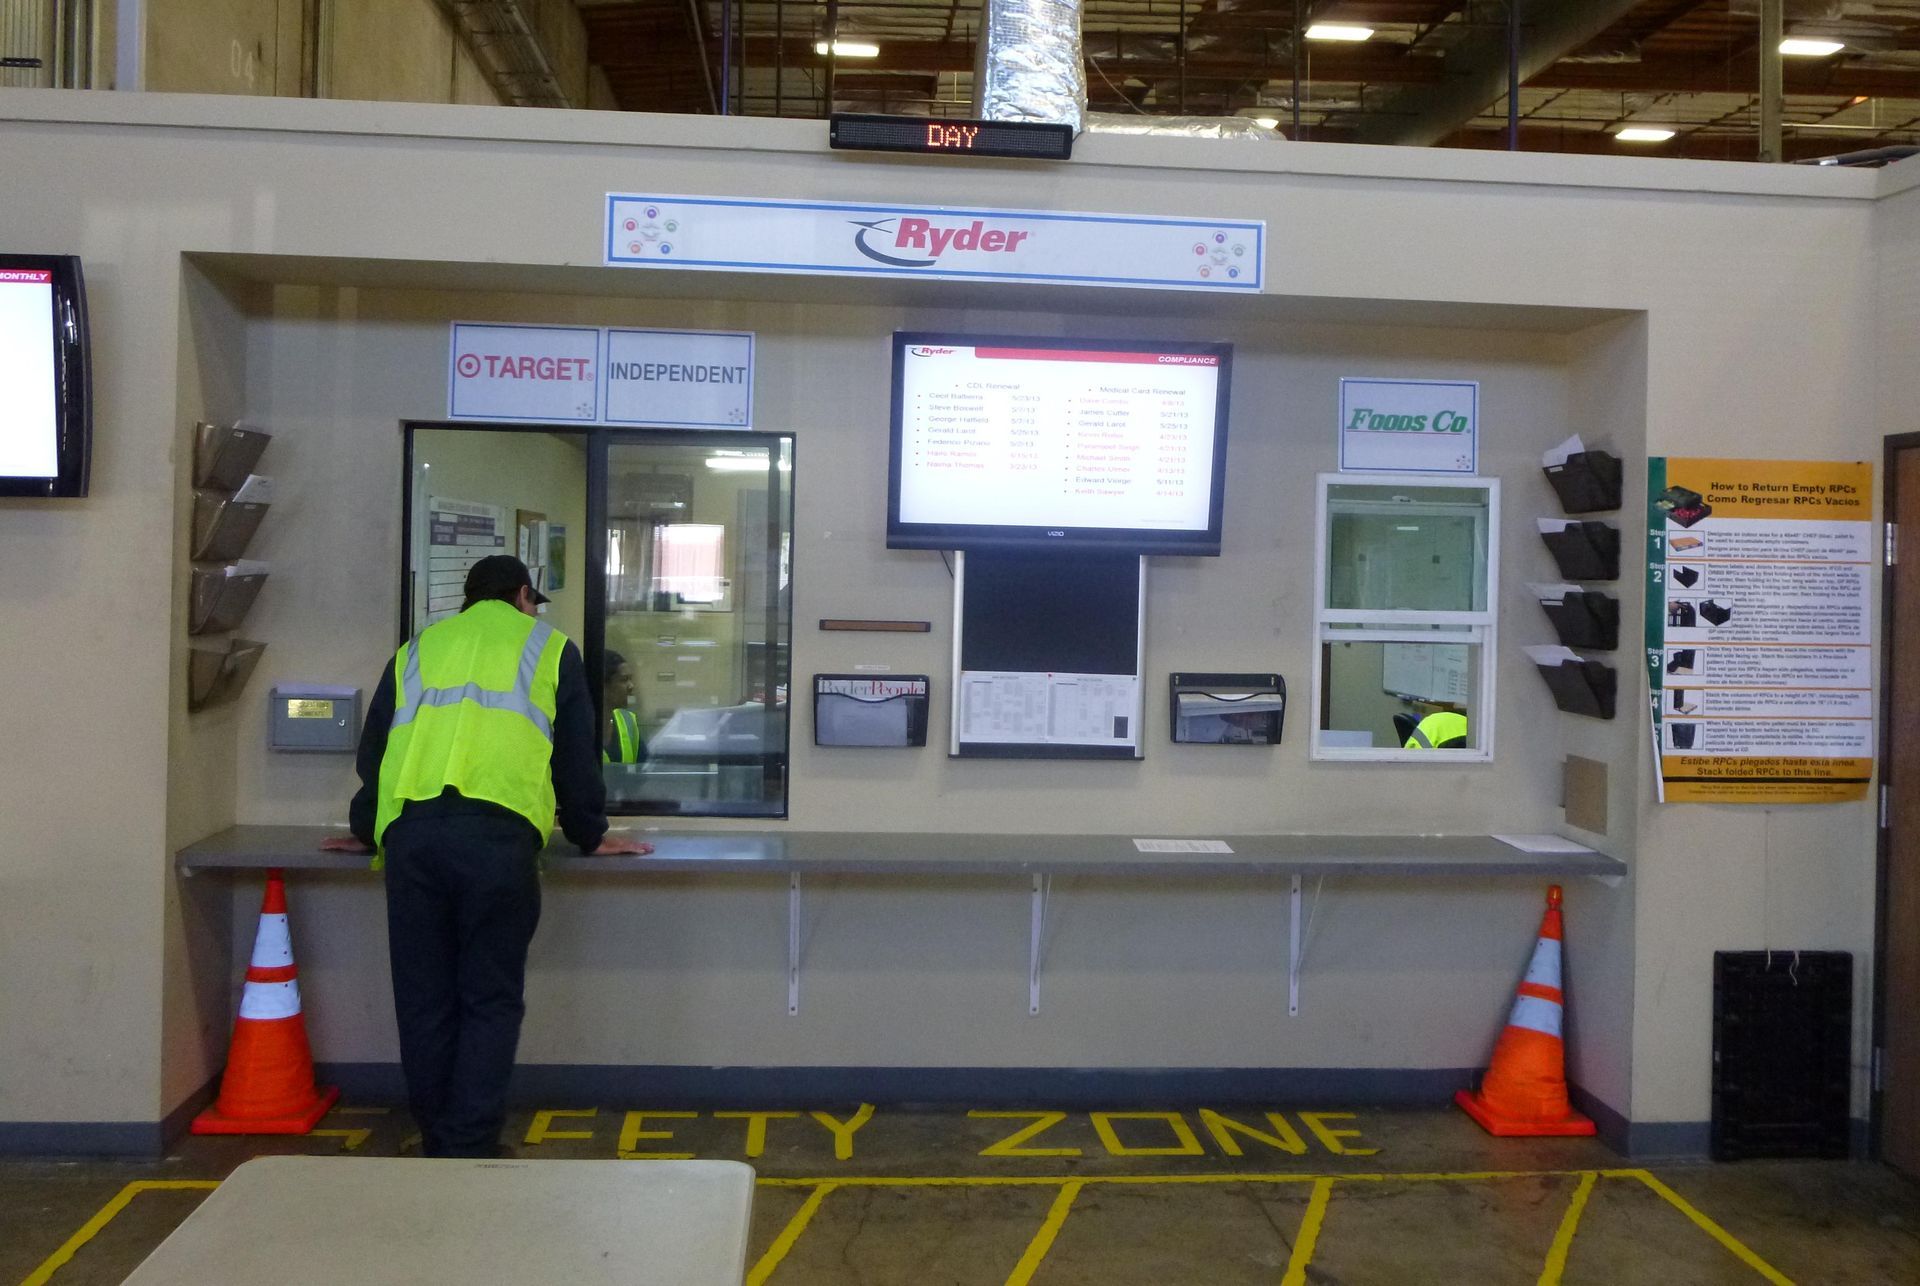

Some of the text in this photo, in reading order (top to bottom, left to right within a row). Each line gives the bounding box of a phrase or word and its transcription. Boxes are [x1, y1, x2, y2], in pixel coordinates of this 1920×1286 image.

[927, 124, 979, 148] DAY
[894, 217, 1029, 257] Ryder
[920, 346, 955, 356] Ryder
[1158, 355, 1217, 365] COMPLIANCE
[484, 355, 590, 381] TARGET
[610, 361, 747, 385] INDEPENDENT
[1710, 481, 1857, 495] How to Return Empty RPCs
[1706, 494, 1738, 504] Como
[1741, 495, 1790, 507] Regresar
[1793, 496, 1822, 506] RPCs
[1047, 530, 1065, 538] VIZIO
[1654, 537, 1661, 549] 1
[1653, 570, 1662, 583] 2
[1647, 648, 1664, 656] Step
[1651, 655, 1660, 667] 3
[1680, 756, 1710, 766] Estibe
[1712, 757, 1738, 766] RPCs
[1739, 757, 1780, 768] plegados
[1782, 758, 1808, 767] hasta
[1696, 767, 1724, 777] Stack
[1726, 767, 1754, 777] folded
[1755, 768, 1781, 777] RPCs
[1782, 768, 1793, 777] to
[1794, 768, 1812, 777] this
[967, 1107, 1385, 1156] ZONE
